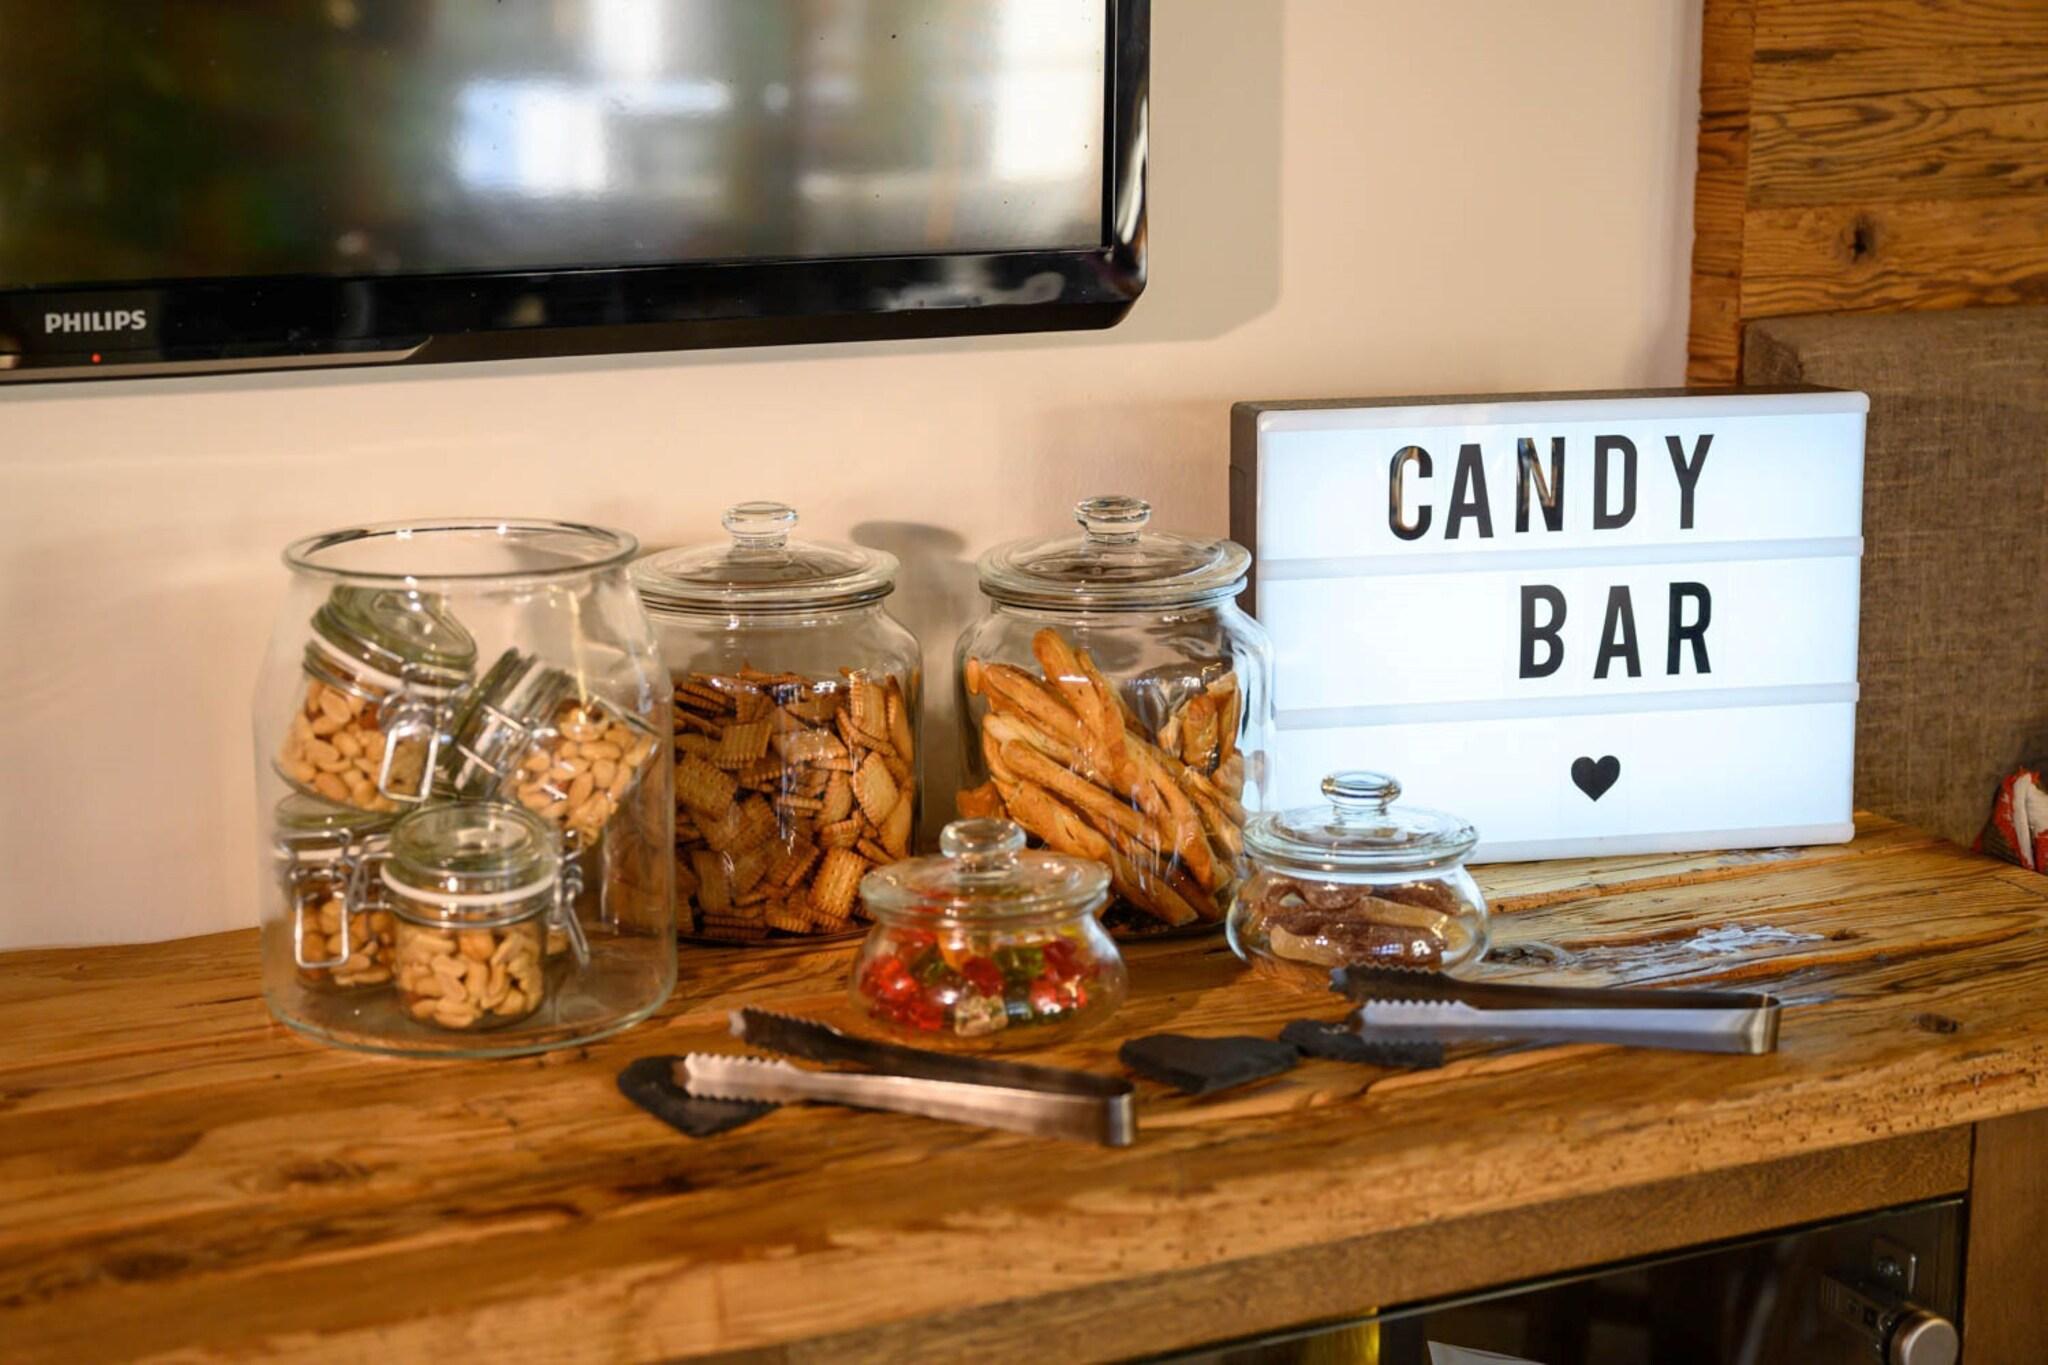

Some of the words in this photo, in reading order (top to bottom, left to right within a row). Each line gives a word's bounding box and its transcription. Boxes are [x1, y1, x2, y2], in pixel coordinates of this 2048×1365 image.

[44, 310, 147, 333] PHILIPS
[1388, 434, 1714, 541] CANDY
[1519, 581, 1712, 679] BAR
